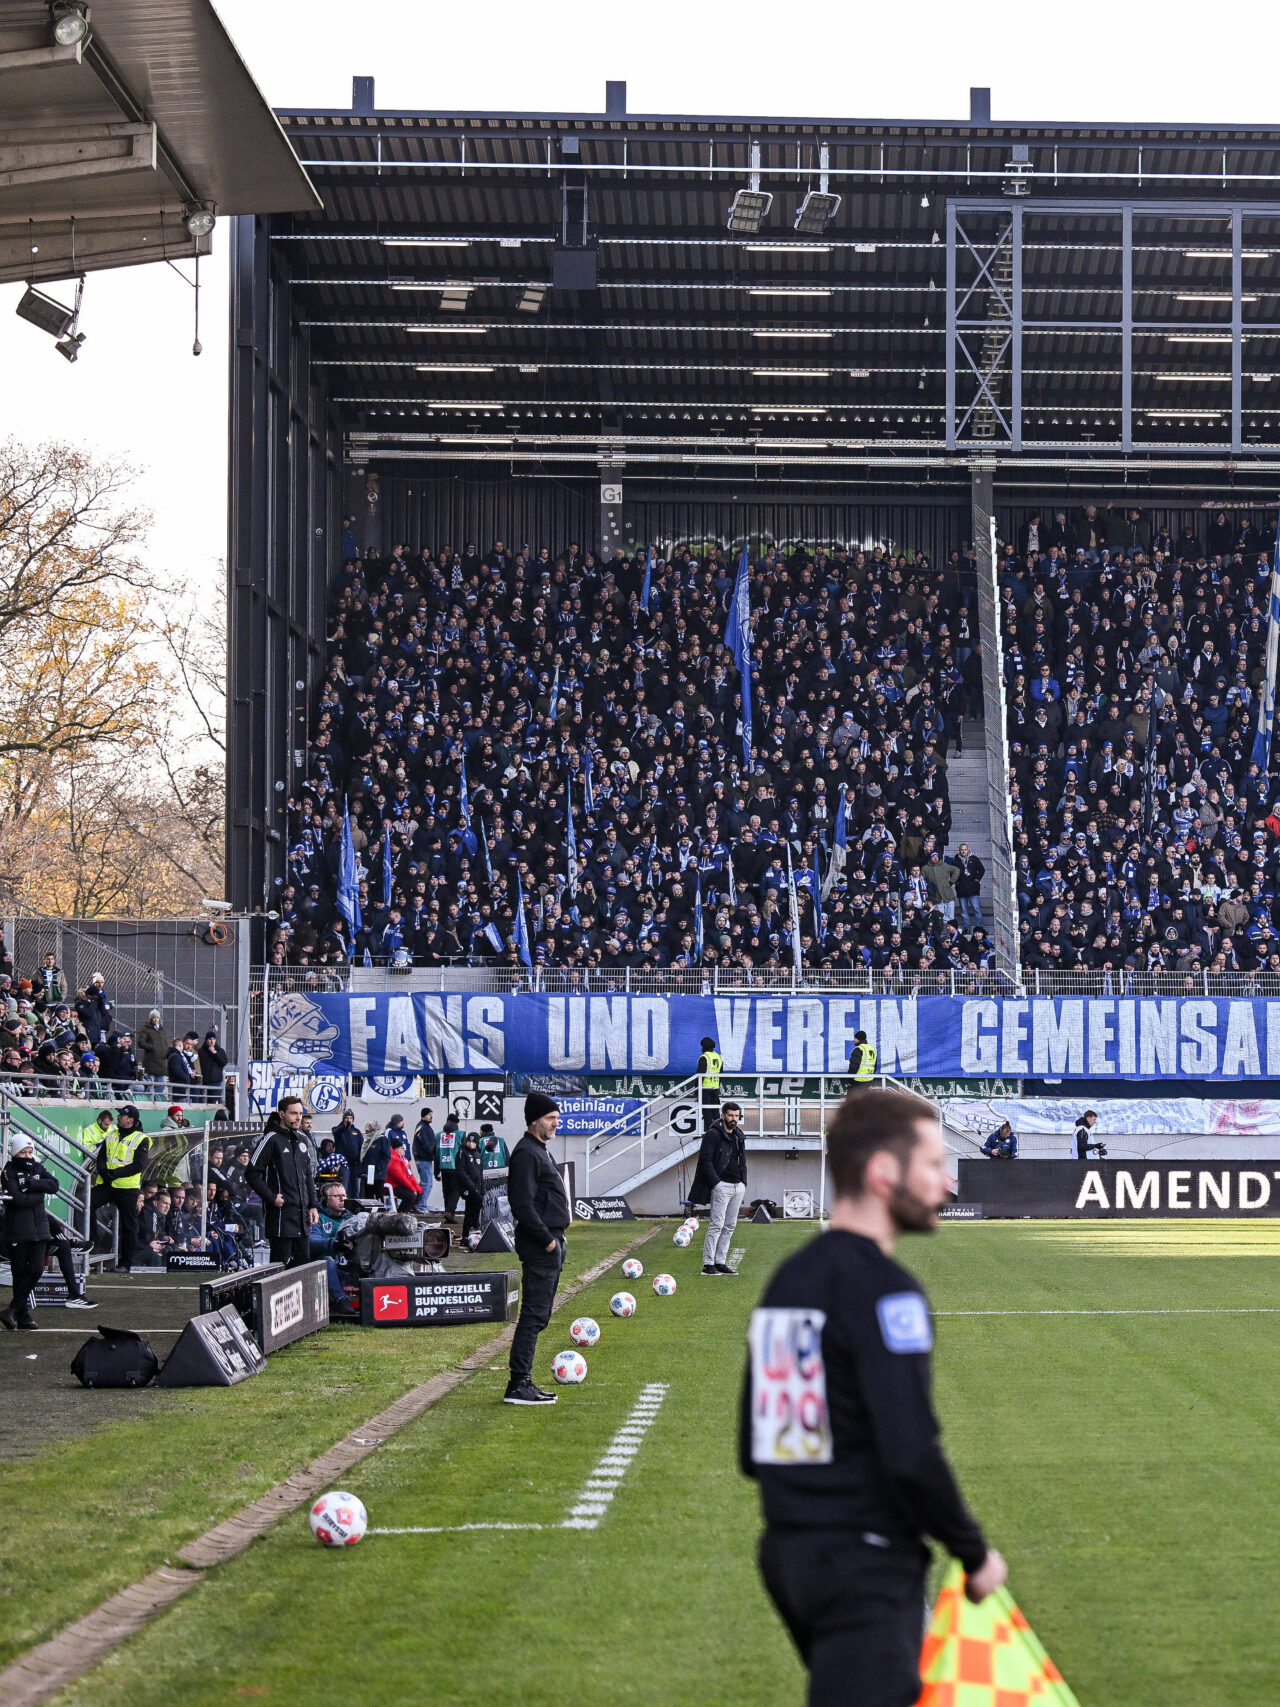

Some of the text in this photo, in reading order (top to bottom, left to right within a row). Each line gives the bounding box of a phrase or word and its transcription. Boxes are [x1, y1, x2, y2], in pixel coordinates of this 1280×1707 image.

[349, 994, 505, 1073] FANS
[548, 995, 671, 1072] UND
[713, 998, 918, 1074] VEREIN
[567, 1118, 611, 1129] Schalke
[414, 1283, 492, 1296] DIE OFFIZIELLE
[415, 1295, 483, 1306] BUNDESLIGA
[415, 1307, 438, 1317] APP
